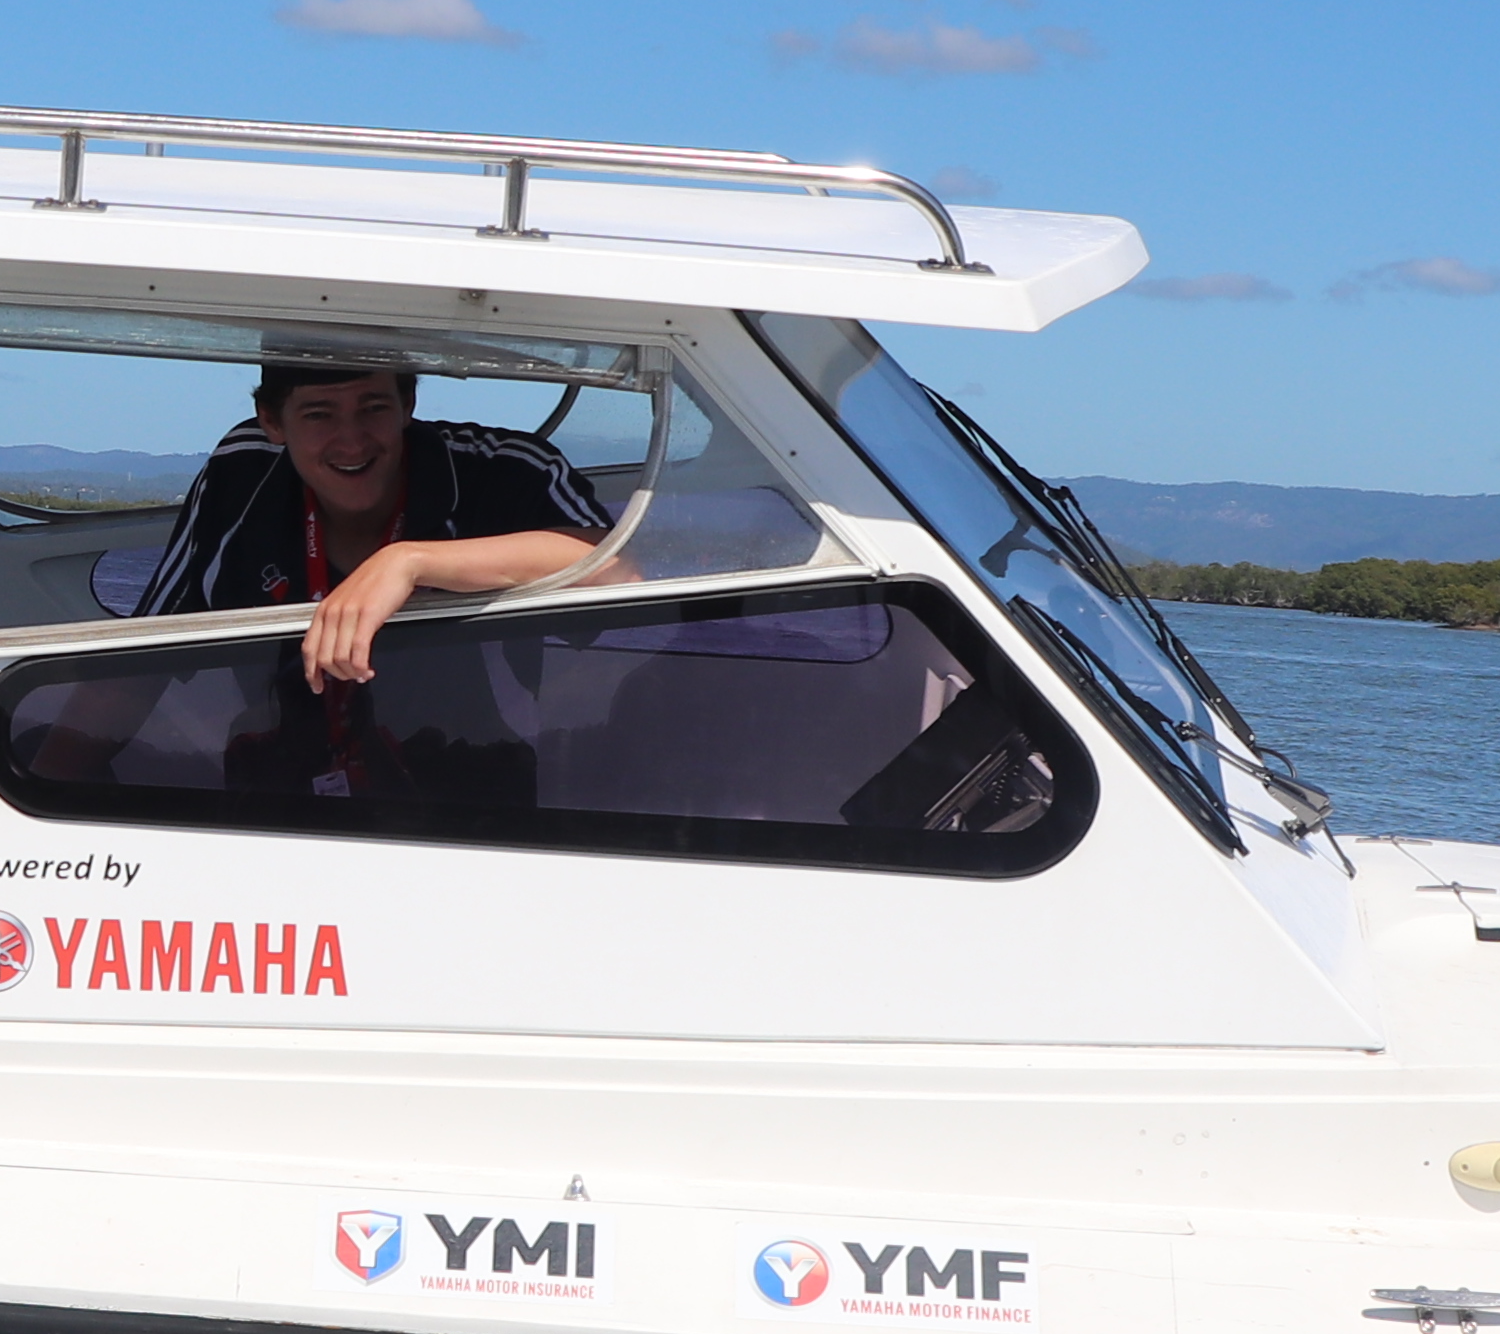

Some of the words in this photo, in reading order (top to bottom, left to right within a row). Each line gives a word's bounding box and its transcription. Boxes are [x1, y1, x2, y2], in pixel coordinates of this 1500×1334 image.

[103, 855, 141, 888] by
[44, 917, 348, 996] YAMAHA
[423, 1213, 595, 1278] YMI
[420, 1275, 471, 1292] YAMAHA
[475, 1279, 519, 1295] MOTOR
[523, 1282, 595, 1299] INSURANCE
[841, 1241, 1029, 1301] YMF
[841, 1299, 904, 1316] YAMAHA
[909, 1302, 962, 1319] MOTOR
[967, 1306, 1031, 1323] FINANCE
